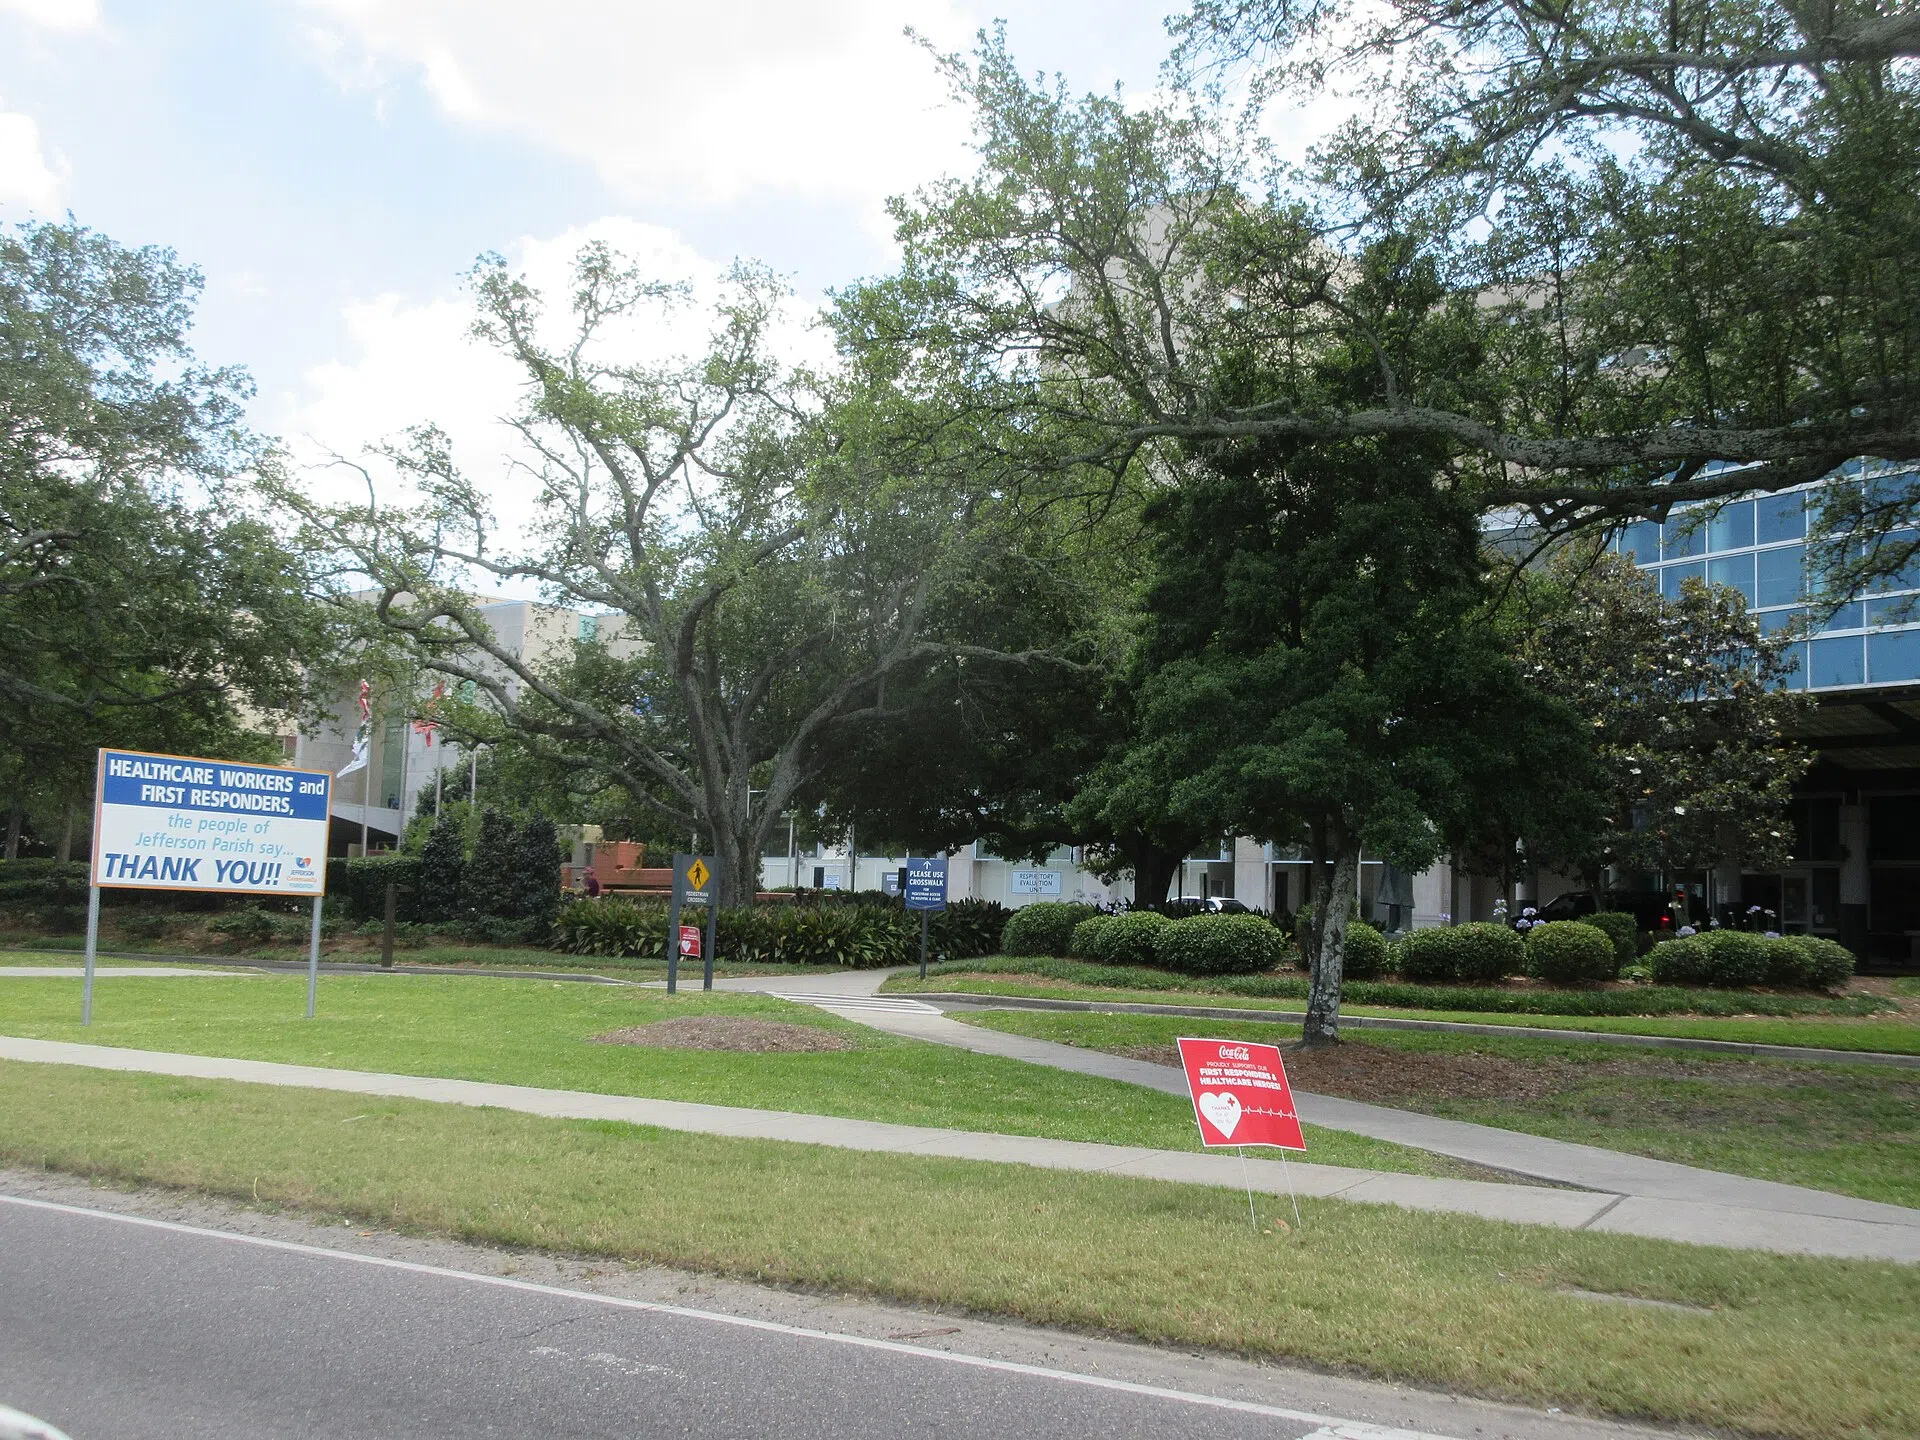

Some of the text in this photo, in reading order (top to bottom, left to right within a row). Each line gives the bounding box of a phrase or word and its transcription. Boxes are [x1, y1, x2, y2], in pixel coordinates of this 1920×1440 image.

[109, 759, 325, 796] HEALTHCARE WORKERS and
[141, 784, 295, 816] FIRST RESPONDERS,
[168, 813, 271, 836] the people of
[135, 832, 294, 859] Jefferson Parish say...
[105, 852, 283, 886] THANK YOU!!
[1199, 1078, 1252, 1086] HEALTHCARE
[1224, 1069, 1271, 1080] RESPONDERS
